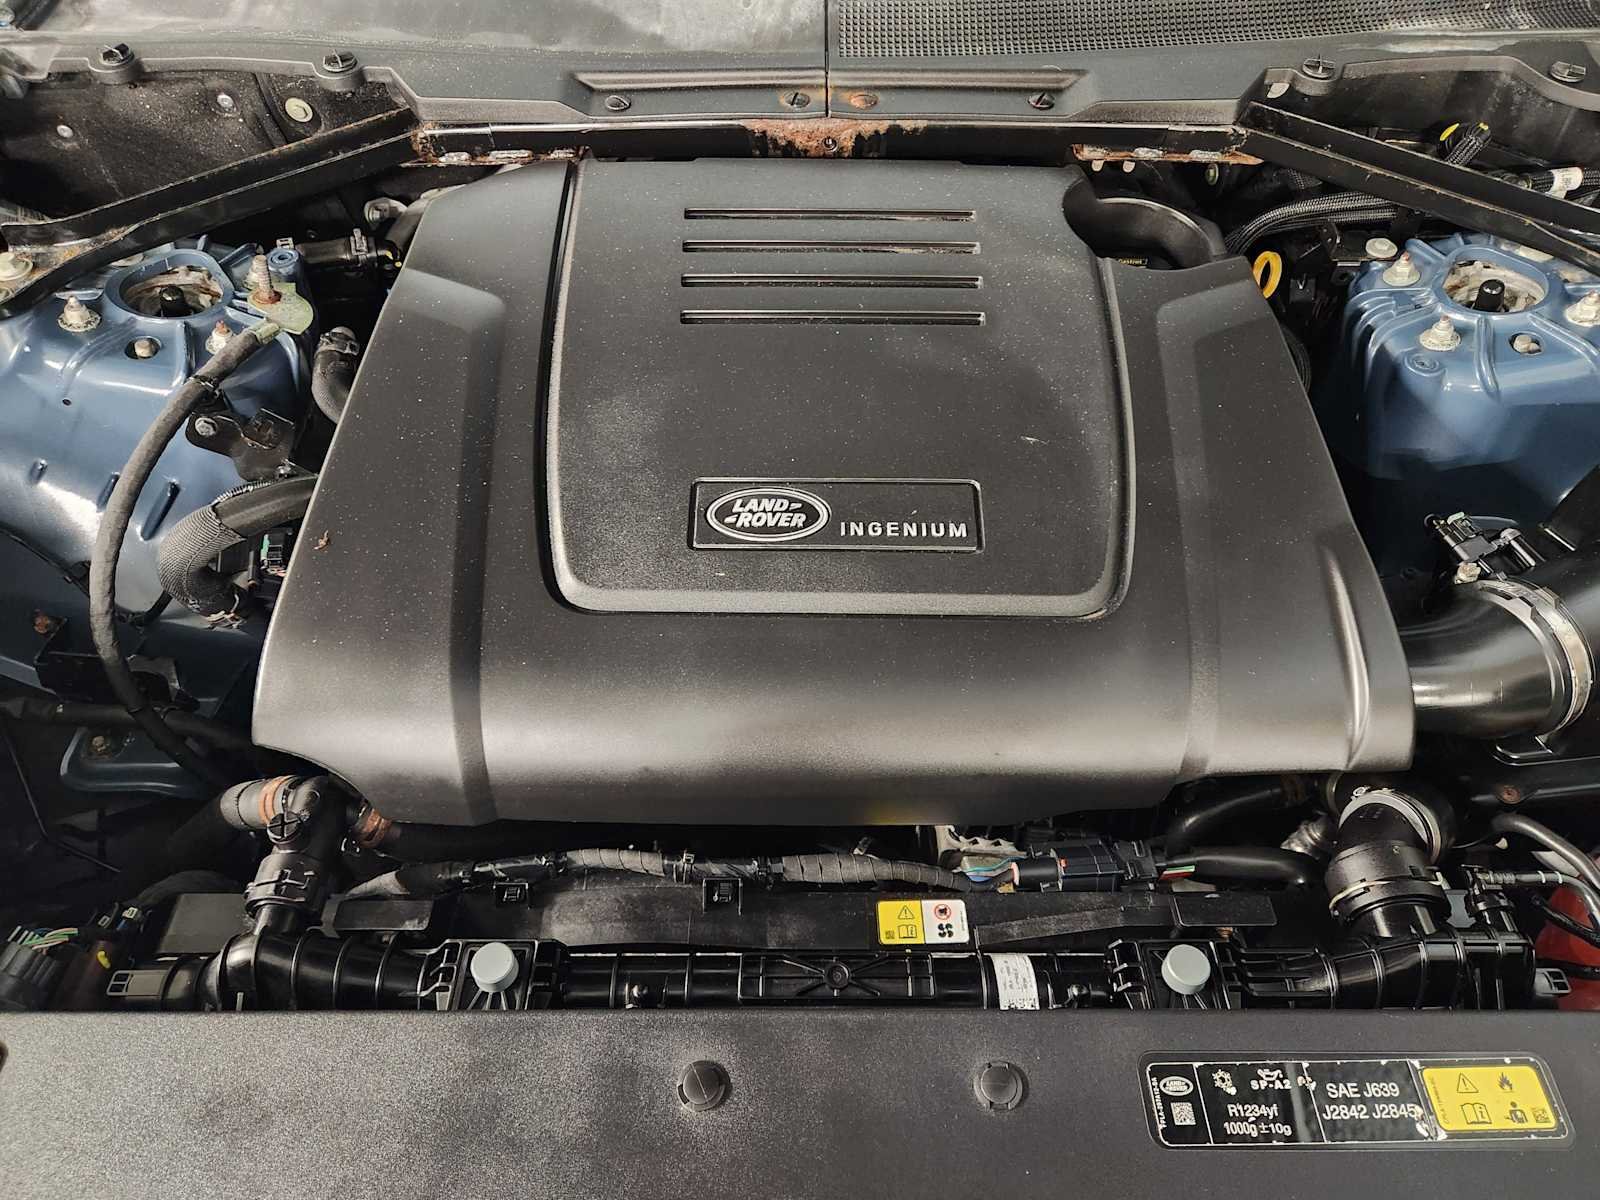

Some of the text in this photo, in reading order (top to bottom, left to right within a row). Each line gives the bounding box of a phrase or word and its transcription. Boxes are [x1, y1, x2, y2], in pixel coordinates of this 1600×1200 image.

[732, 498, 790, 513] LAND
[739, 512, 806, 528] ROVER
[839, 521, 968, 538] INGENIUM
[1250, 1079, 1292, 1090] SP-A2
[1326, 1082, 1400, 1098] SAE J639
[1227, 1103, 1279, 1119] R1234yf
[1322, 1103, 1417, 1120] J2842 J2845
[1224, 1121, 1293, 1138] 1000g ±10g
